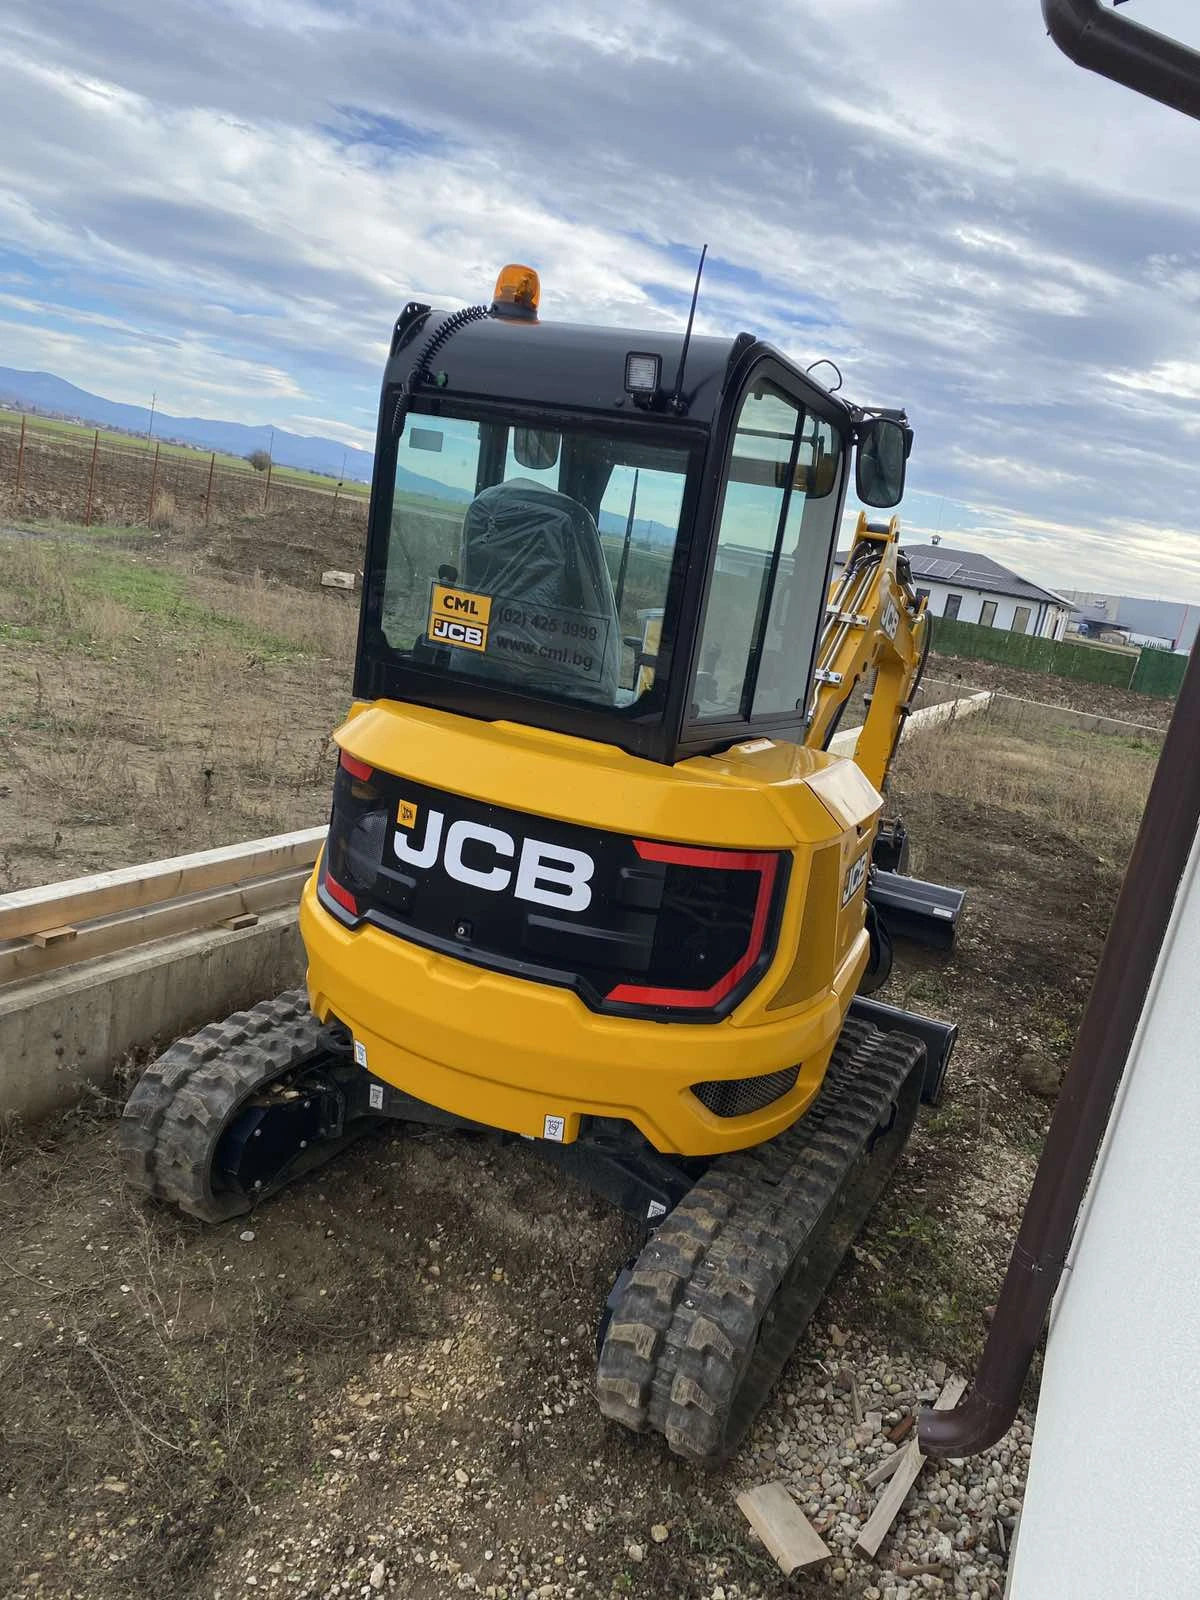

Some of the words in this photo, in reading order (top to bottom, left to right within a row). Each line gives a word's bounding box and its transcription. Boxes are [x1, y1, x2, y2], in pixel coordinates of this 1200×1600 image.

[443, 595, 479, 616] CML
[880, 600, 899, 639] JCB
[434, 620, 482, 646] JCB
[496, 635, 593, 671] www.cml.bg
[393, 809, 595, 912] JCB
[842, 851, 868, 905] JCB
